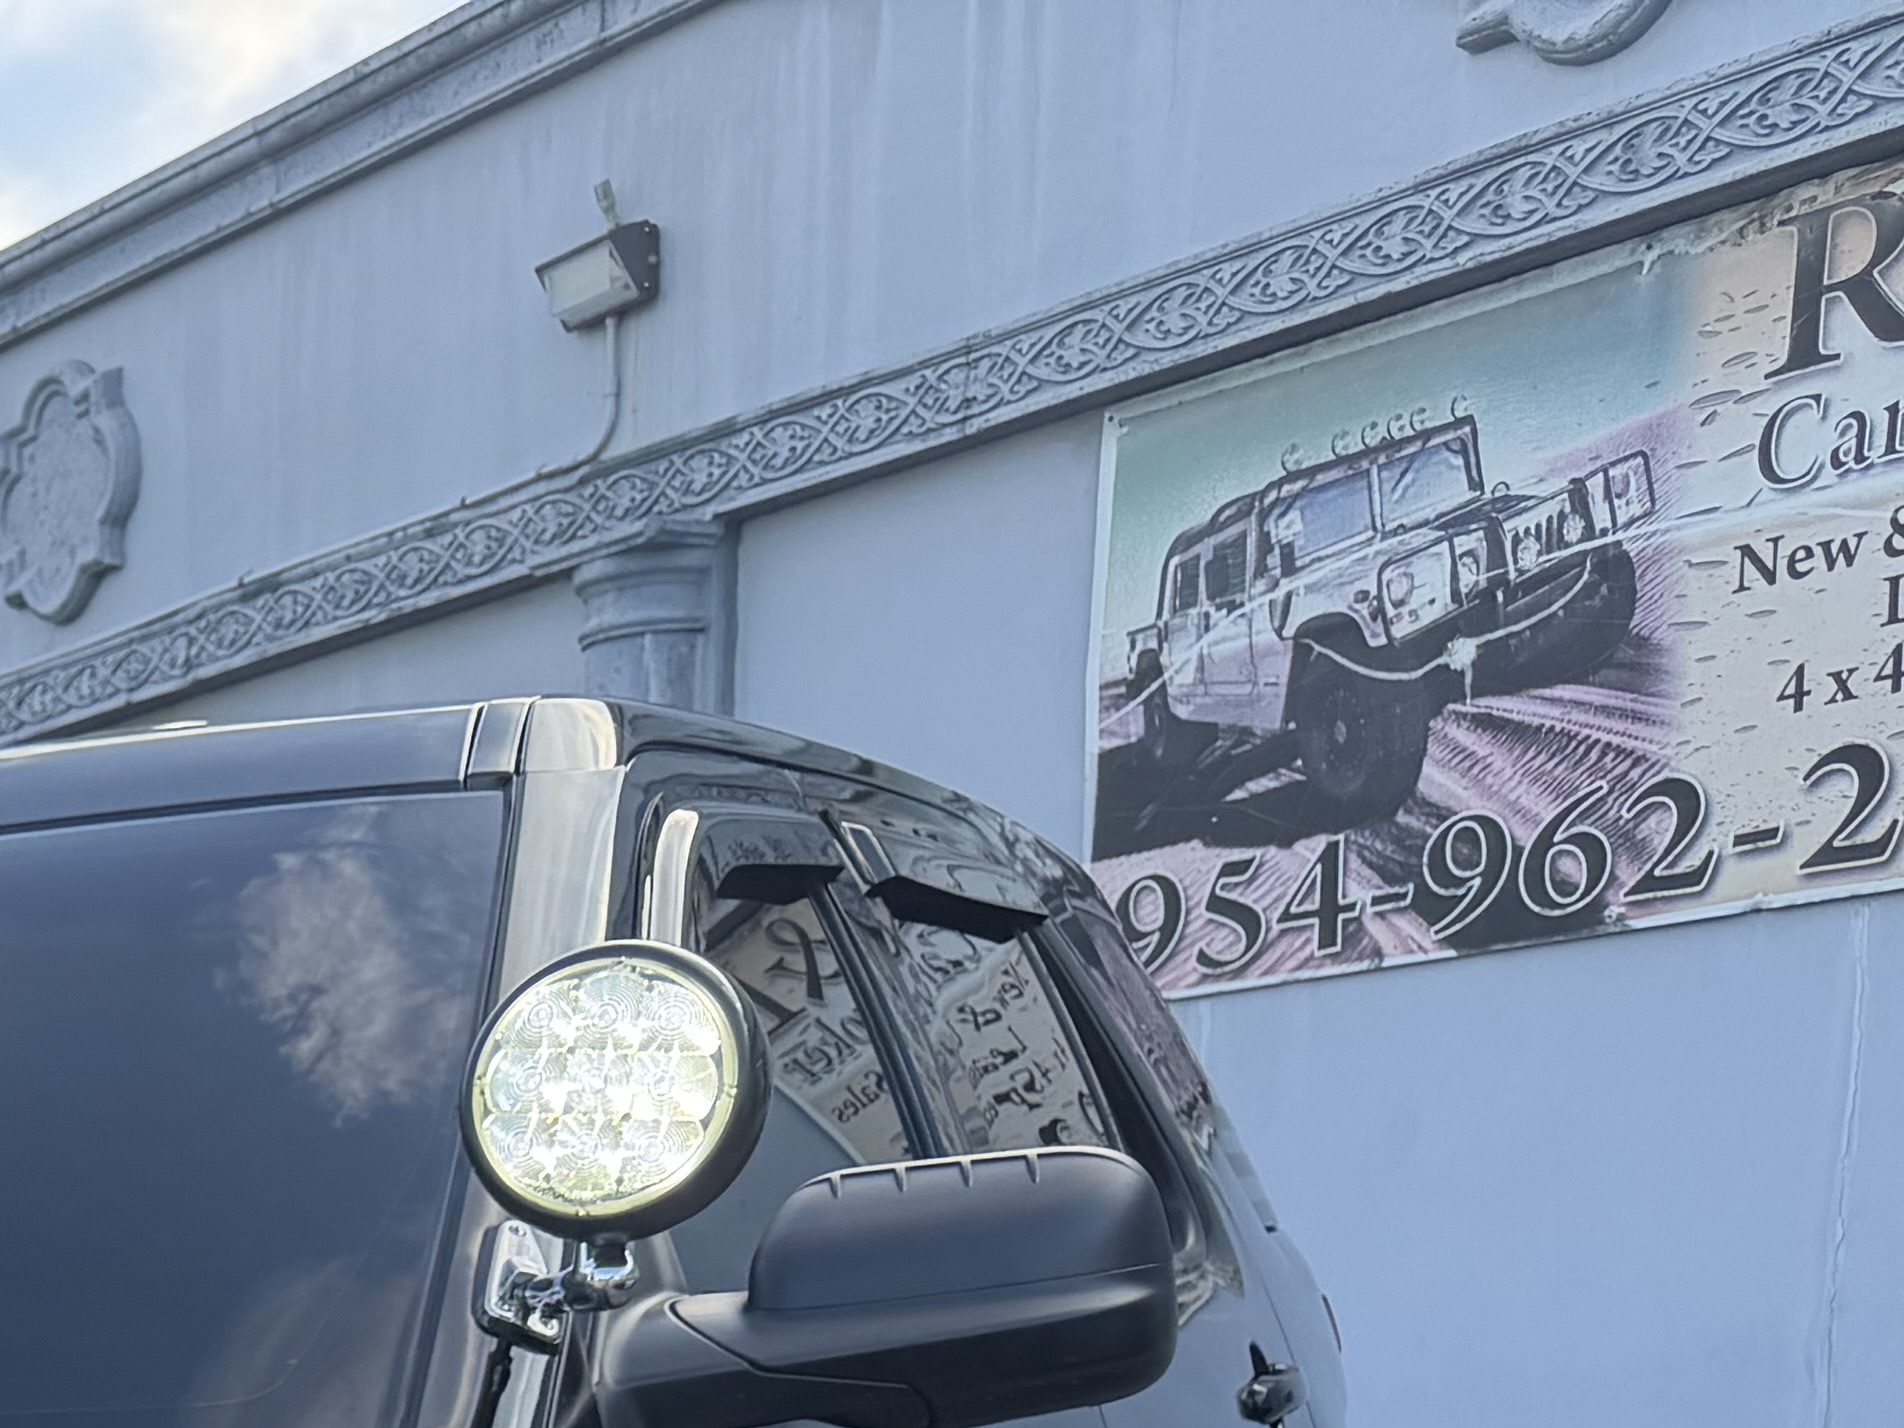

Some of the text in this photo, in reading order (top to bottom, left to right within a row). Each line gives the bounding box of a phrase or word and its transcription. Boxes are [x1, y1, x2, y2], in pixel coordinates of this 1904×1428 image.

[1732, 534, 1869, 595] New
[1776, 662, 1812, 714] 4
[1824, 667, 1860, 705] x
